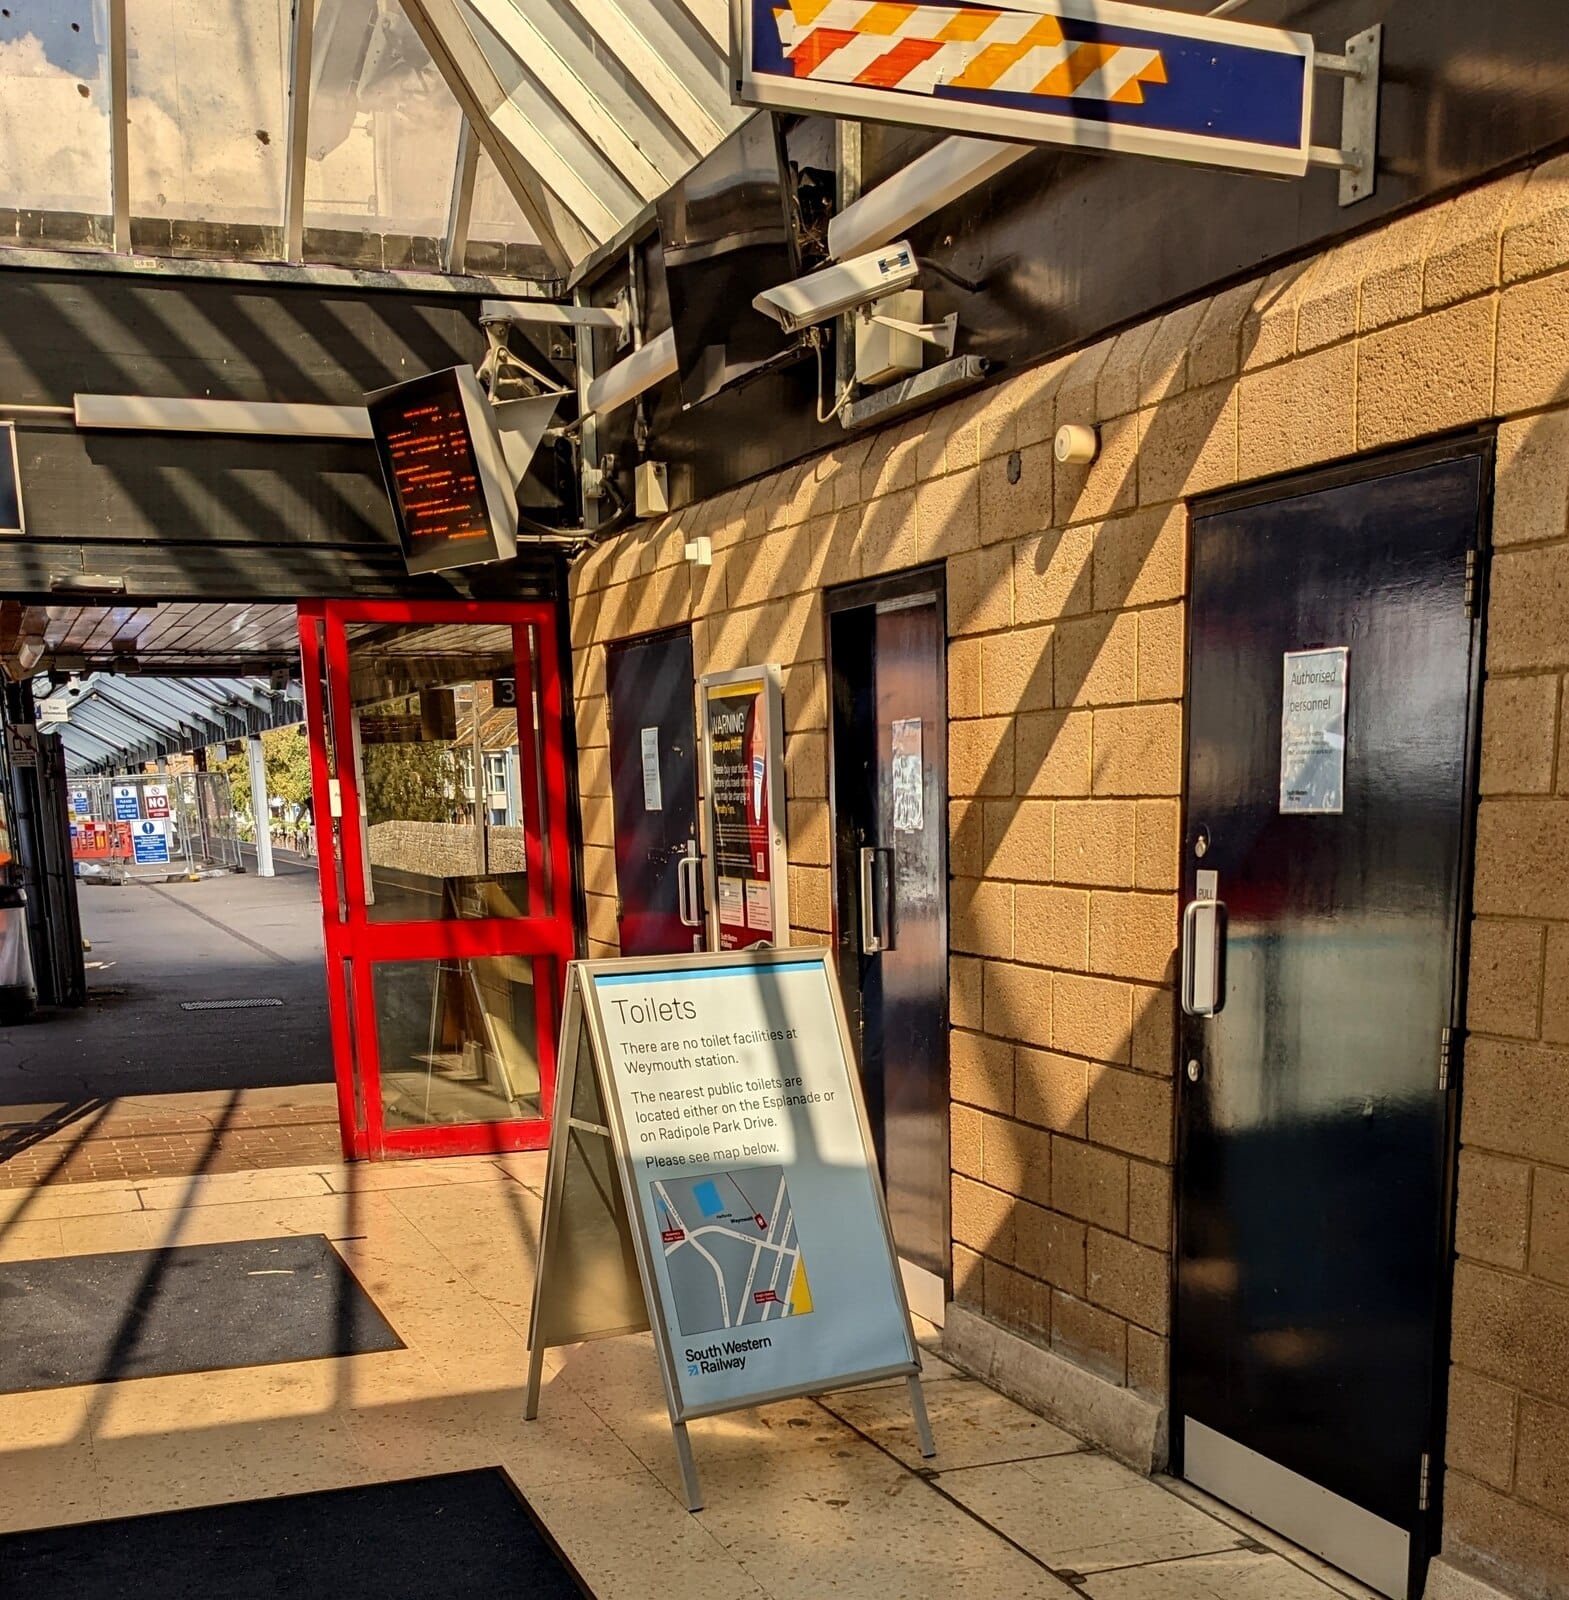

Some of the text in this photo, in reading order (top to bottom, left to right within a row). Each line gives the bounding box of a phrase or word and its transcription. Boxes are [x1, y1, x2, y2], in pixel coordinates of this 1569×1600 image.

[1291, 667, 1336, 685] Authorised
[502, 682, 515, 703] 3
[1289, 696, 1331, 712] personnel
[712, 713, 744, 735] WARNING
[148, 797, 165, 808] NO
[1198, 888, 1213, 899] PULL
[611, 997, 697, 1025] Toilets
[620, 1028, 798, 1055] There are no toilet facilities at
[624, 1054, 739, 1076] Weymouth station.
[631, 1076, 802, 1104] The nearest public toilets are
[635, 1090, 835, 1124] located either on the Esplanade or
[640, 1116, 777, 1143] on Radipole Park Drive.
[645, 1142, 779, 1168] Please see map below.
[685, 1337, 772, 1362] South Western
[701, 1356, 746, 1374] Railway
